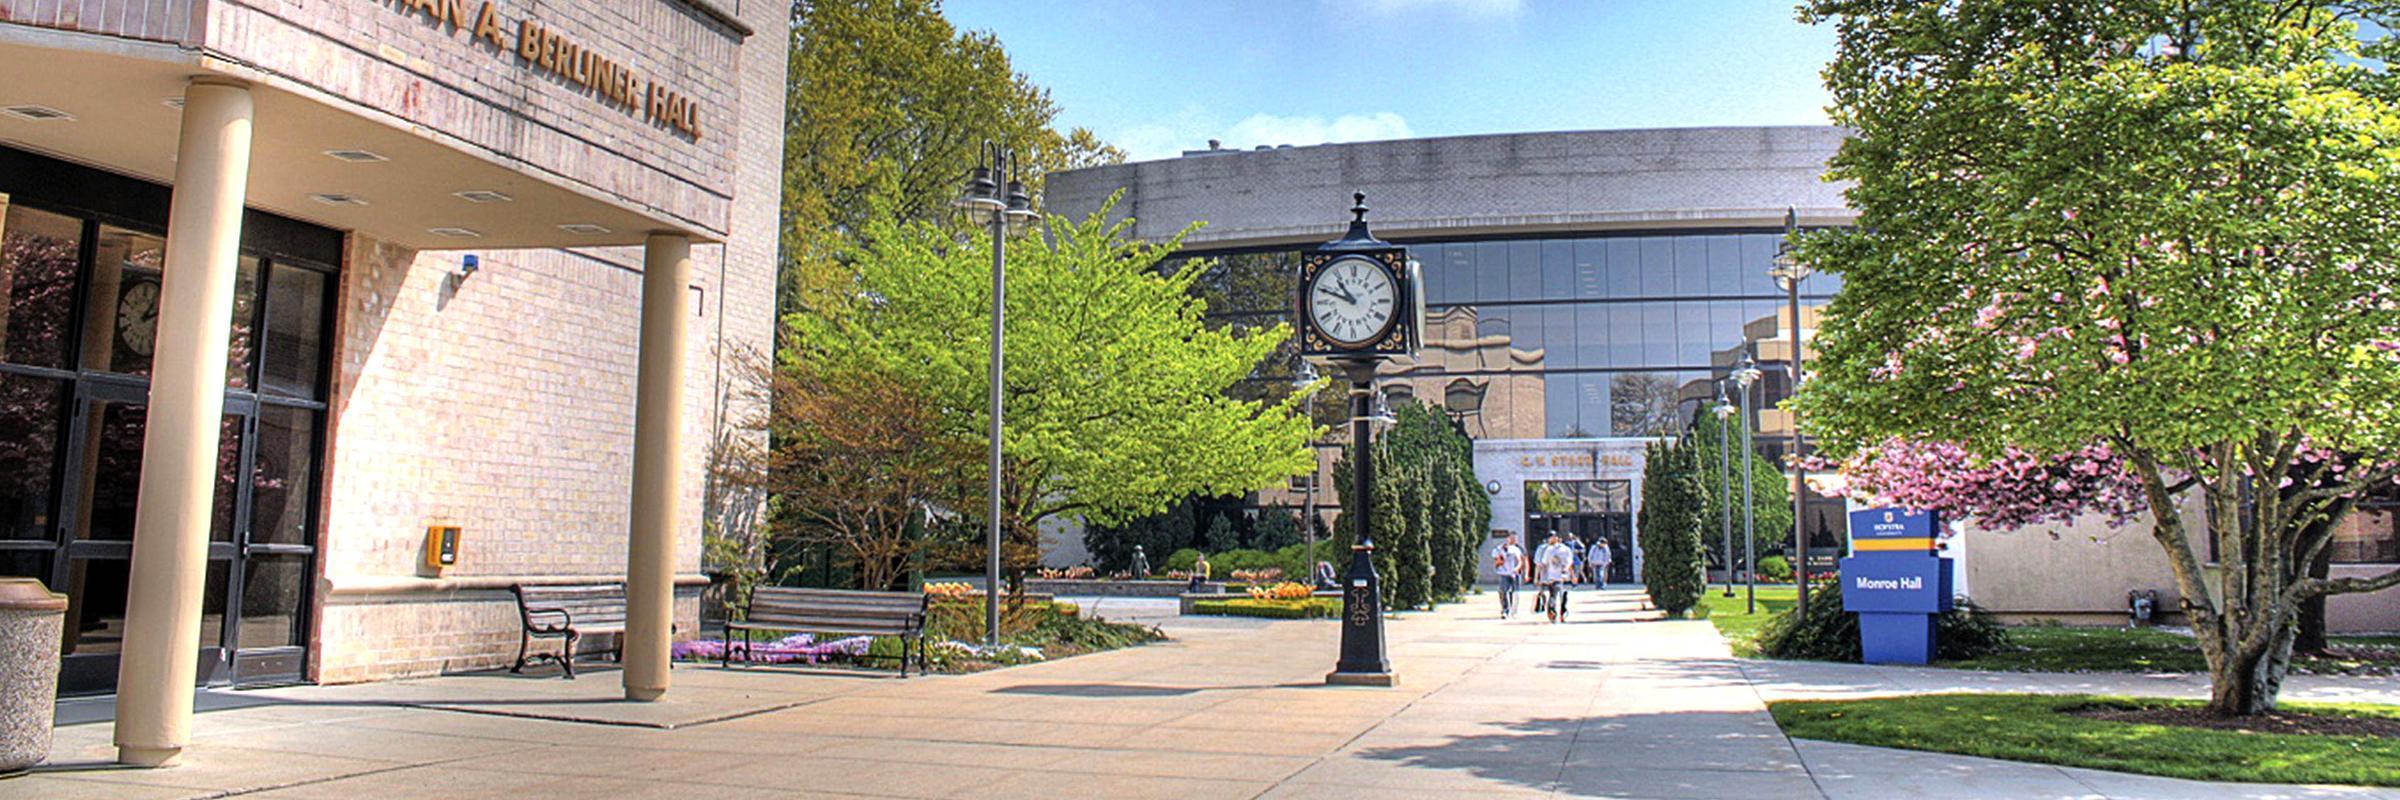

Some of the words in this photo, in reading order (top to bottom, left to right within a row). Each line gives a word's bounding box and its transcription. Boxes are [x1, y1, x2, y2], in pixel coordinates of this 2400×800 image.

[518, 19, 640, 111] BERLINER
[648, 81, 703, 140] HALL
[1856, 576, 1898, 589] Monroe
[1900, 576, 1922, 589] Hall
